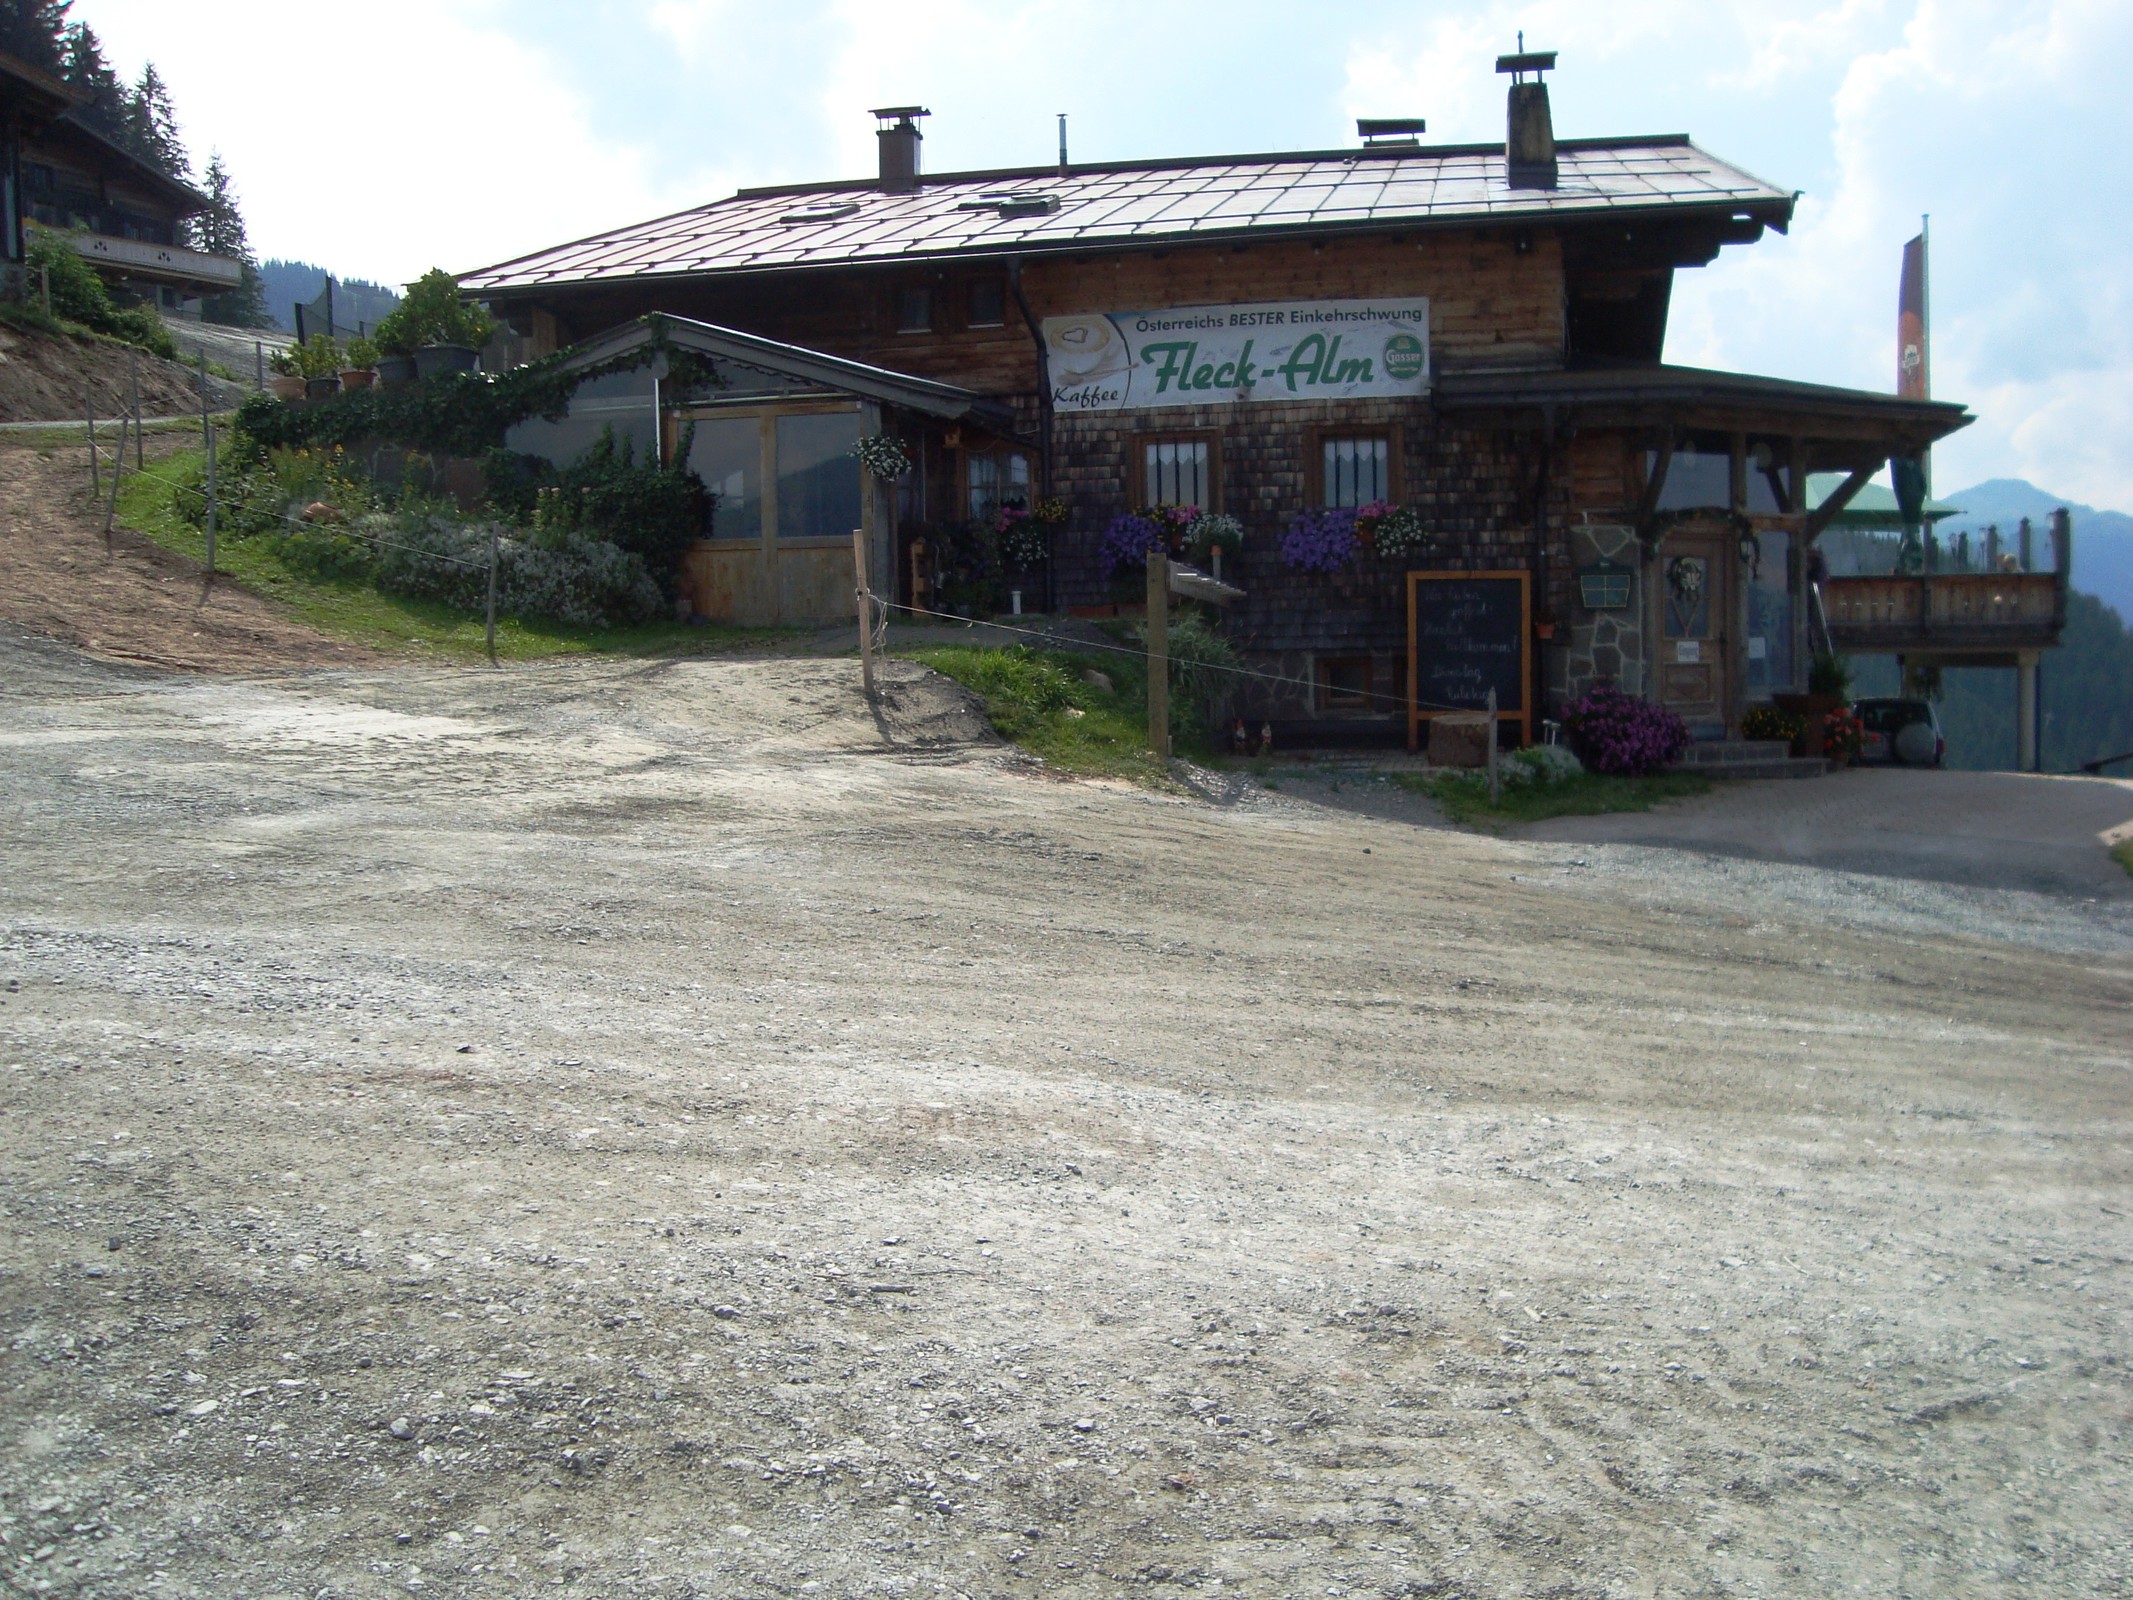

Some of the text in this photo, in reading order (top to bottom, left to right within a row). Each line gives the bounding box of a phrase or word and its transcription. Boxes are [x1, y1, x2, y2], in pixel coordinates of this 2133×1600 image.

[1136, 307, 1422, 332] Österreichs BESTER Einkehrschwung
[1140, 333, 1374, 393] Fleck-Alm
[1052, 386, 1118, 408] Kaffee
